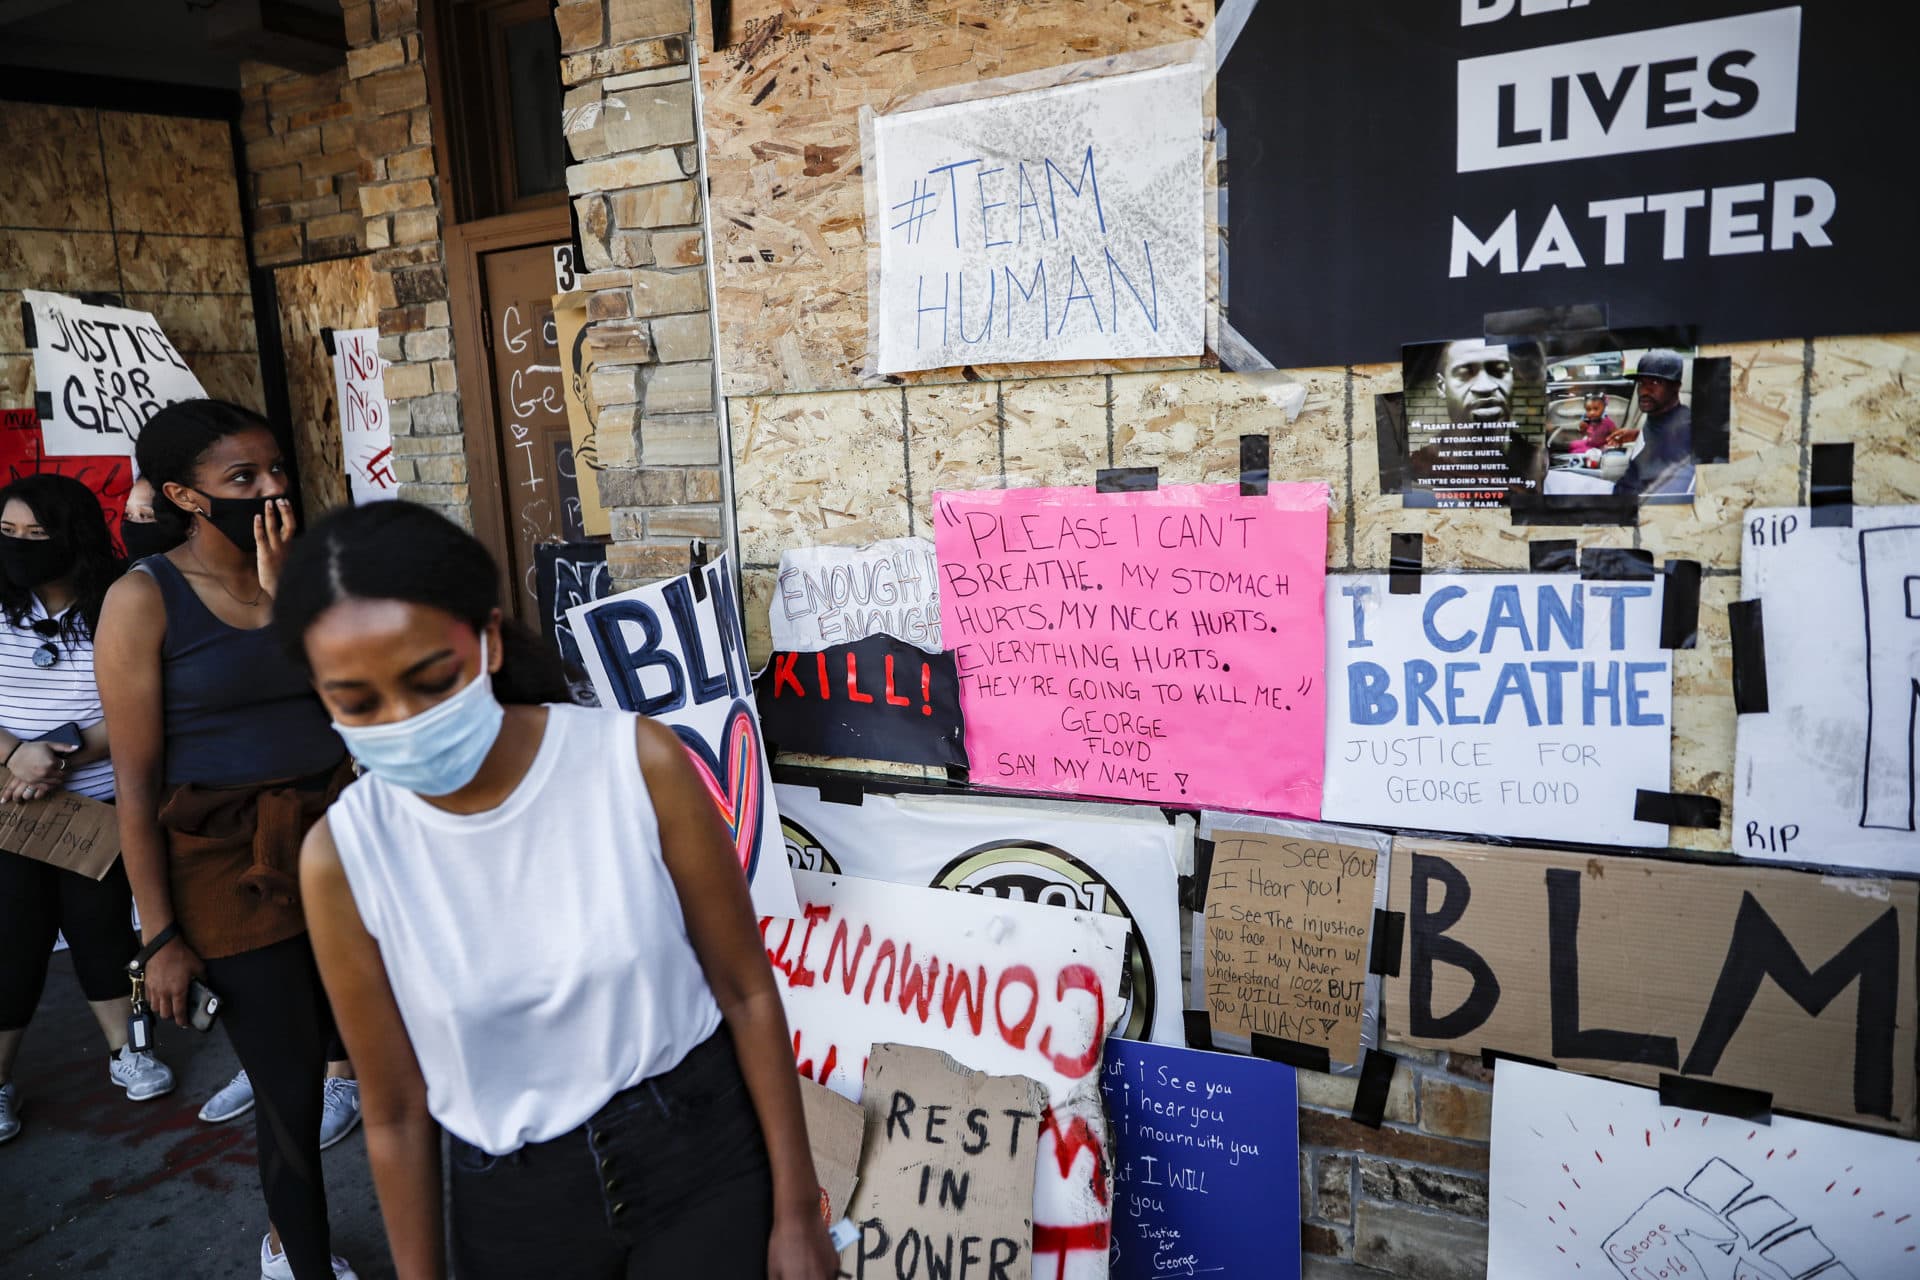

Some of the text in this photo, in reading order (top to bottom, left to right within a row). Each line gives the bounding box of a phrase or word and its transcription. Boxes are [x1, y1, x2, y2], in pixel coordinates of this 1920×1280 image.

[1497, 50, 1760, 148] LIVES
[892, 145, 1106, 248] #TEAM
[1448, 177, 1837, 278] MATTER
[917, 240, 1157, 349] HUMAN
[51, 309, 188, 371] JUSTICE
[94, 367, 155, 399] FOR
[1443, 436, 1482, 444] STOMACH
[1457, 422, 1480, 430] CAN'T
[1483, 421, 1519, 429] BREATHE.
[1132, 513, 1139, 548] I
[1157, 513, 1257, 550] CAN'T
[778, 549, 940, 622] ENOUGH!
[942, 559, 1290, 598] BREATHE. MY STOMACH
[584, 553, 753, 718] BLM
[954, 600, 1278, 637] HURTS. MY NECK HURTS.
[1342, 583, 1653, 654] I CANT
[953, 639, 1231, 673] EVERYTHING HURTS.
[774, 651, 932, 717] KILL!
[957, 673, 1059, 699] THEY'RE
[1068, 677, 1141, 702] GOING
[1152, 682, 1183, 703] TO
[1193, 683, 1247, 707] KILL
[1347, 659, 1668, 727] BREATHE
[1061, 705, 1168, 739] GEORGE
[997, 751, 1037, 778] SAY
[1053, 755, 1090, 780] MY
[1082, 736, 1152, 763] FLOYD
[1343, 735, 1601, 768] JUSTICE FOR
[1386, 776, 1580, 806] GEORGE FLOYD
[1219, 839, 1268, 863] I
[1282, 842, 1330, 870] See
[1745, 821, 1800, 853] RIP
[1211, 871, 1238, 891] I
[1247, 867, 1297, 900] Hear
[1207, 903, 1366, 941] I See The injustice
[1243, 950, 1259, 964] I
[1268, 952, 1292, 973] May
[1298, 957, 1342, 977] Never
[1292, 936, 1337, 959] Mourn
[1206, 965, 1365, 1001] understand 100% BUT
[1208, 983, 1231, 996] I
[1237, 986, 1289, 1006] WILL
[1293, 992, 1341, 1017] Stand
[1409, 852, 1899, 1120] BLM
[1139, 1060, 1145, 1082] i
[1206, 1080, 1233, 1100] you
[1124, 1083, 1130, 1106] i
[1141, 1089, 1186, 1117] hear
[1190, 1107, 1225, 1128] you
[886, 1090, 1037, 1160] REST
[1124, 1114, 1260, 1166] i mourn with you
[918, 1164, 970, 1212] IN
[1140, 1155, 1163, 1186] I
[1168, 1162, 1209, 1194] WILL
[1129, 1193, 1165, 1217] you
[1138, 1222, 1182, 1240] Justice
[1159, 1240, 1176, 1251] for
[1609, 1223, 1671, 1264] George
[1153, 1251, 1200, 1276] George
